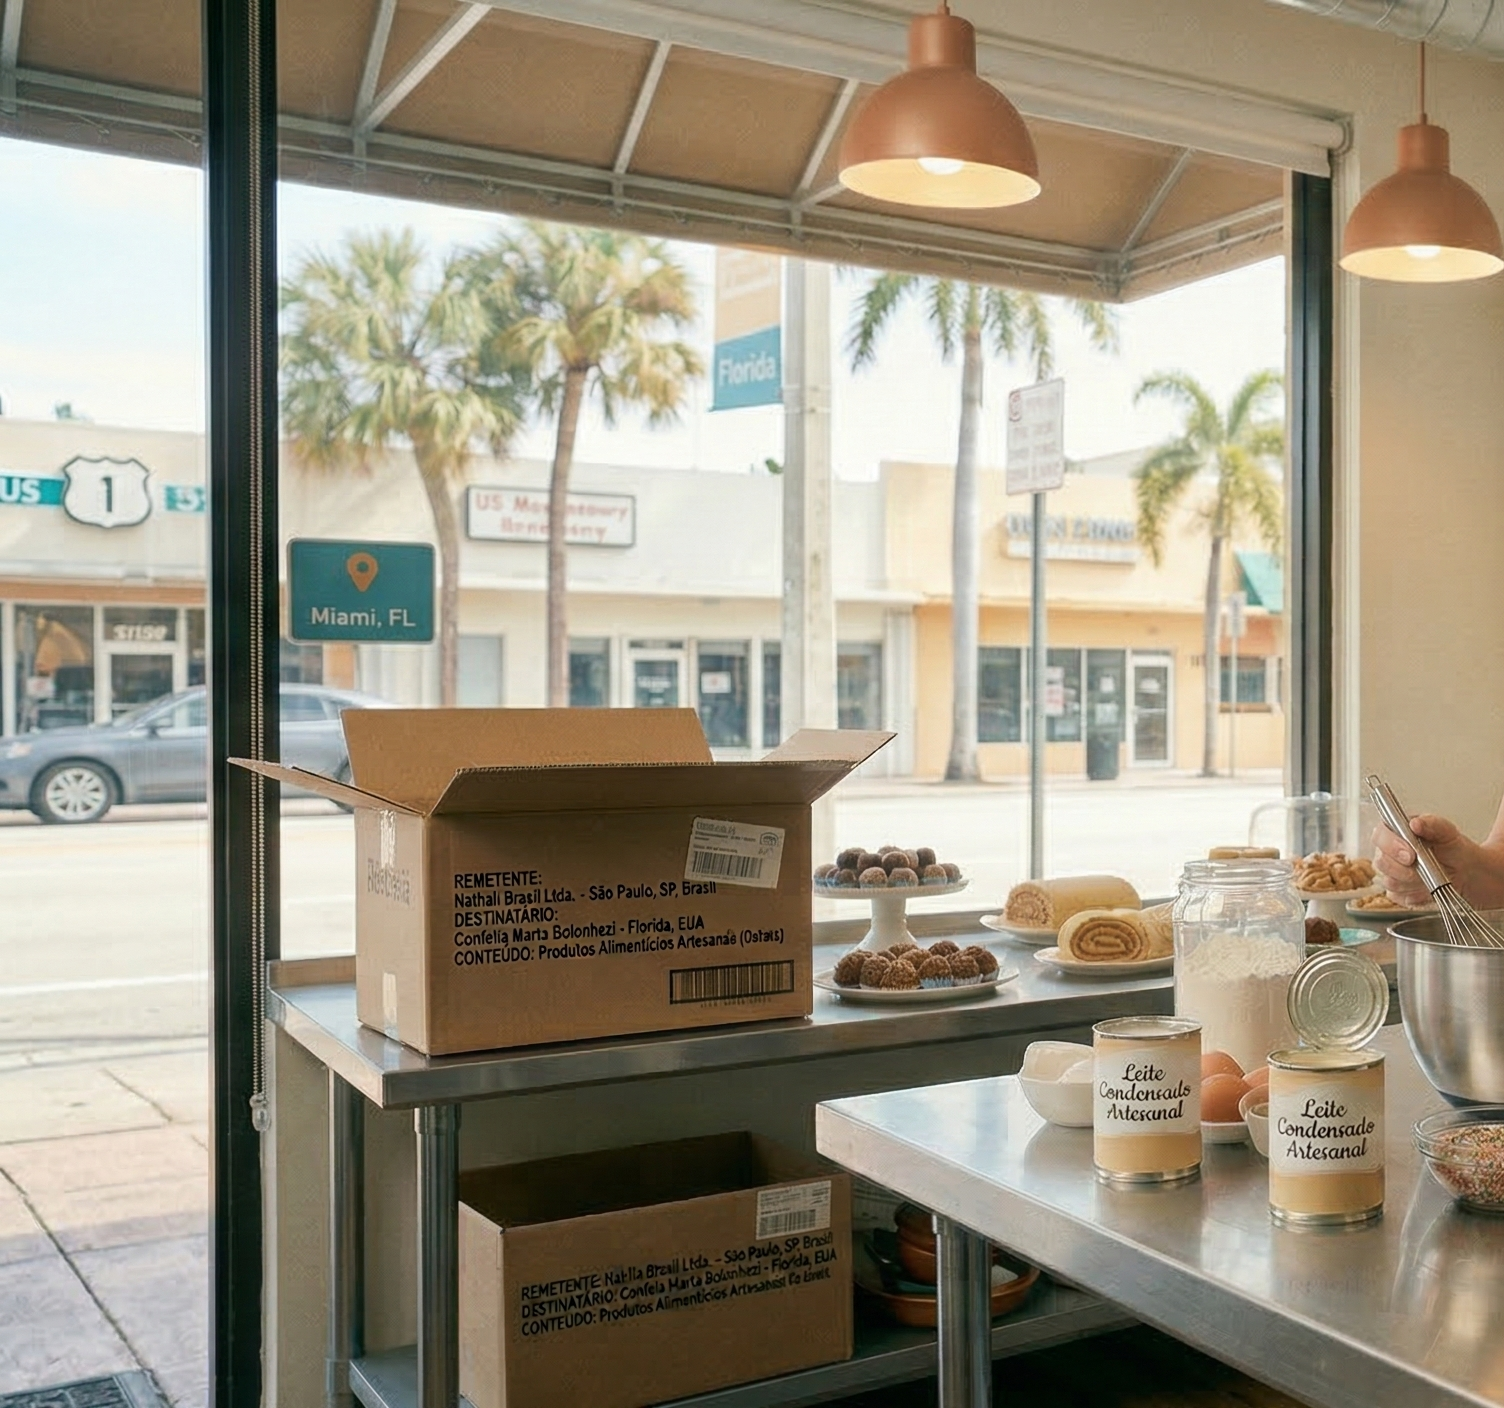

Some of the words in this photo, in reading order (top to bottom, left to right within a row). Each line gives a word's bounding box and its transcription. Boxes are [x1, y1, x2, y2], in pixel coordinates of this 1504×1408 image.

[718, 351, 776, 386] Florida
[101, 476, 113, 513] 1
[310, 606, 382, 628] Miami,
[389, 608, 416, 627] FL
[454, 870, 542, 889] REMETENTE:
[588, 885, 613, 900] São
[617, 883, 656, 900] Paulo,
[659, 882, 678, 898] SP,
[454, 904, 559, 928] DESTINATÁRIO:
[553, 921, 616, 940] Bolonhezi
[628, 917, 674, 935] Florida,
[678, 915, 704, 931] EUA
[454, 943, 535, 966] CONTEÚDO:
[1122, 1063, 1167, 1082] Leite
[1300, 1098, 1348, 1119] Leite
[1286, 1137, 1368, 1160] Artesanal
[814, 1247, 837, 1264] EUA
